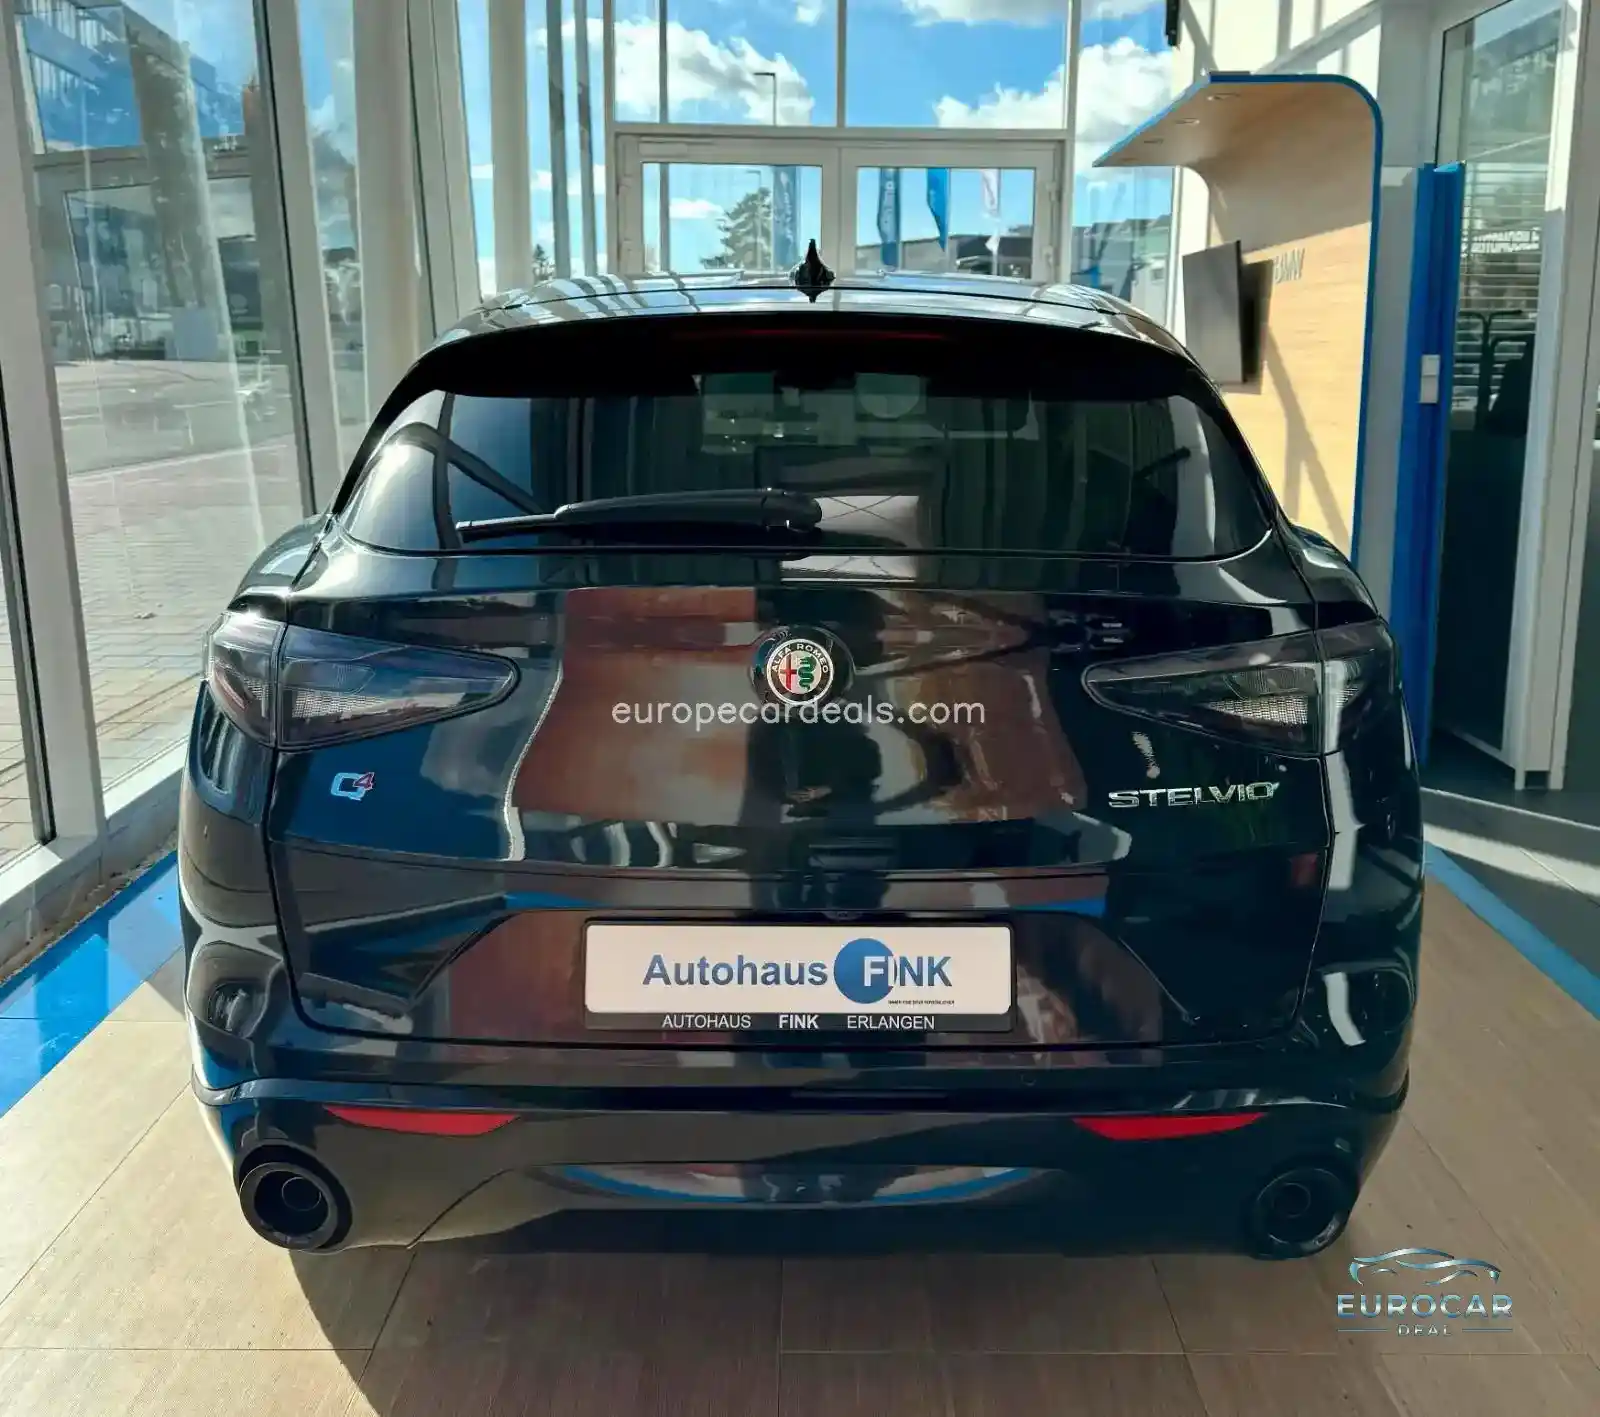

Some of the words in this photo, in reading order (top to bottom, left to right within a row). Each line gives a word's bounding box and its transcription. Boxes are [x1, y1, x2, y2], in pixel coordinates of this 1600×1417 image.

[772, 647, 791, 673] ALFA
[796, 643, 829, 674] ROMEO
[1108, 782, 1280, 808] STELVIO
[642, 954, 828, 987] Autohaus
[863, 955, 952, 987] FINK
[662, 1014, 752, 1030] AUTOHAUS
[778, 1014, 819, 1030] FINK
[847, 1015, 935, 1031] ERLANGEN
